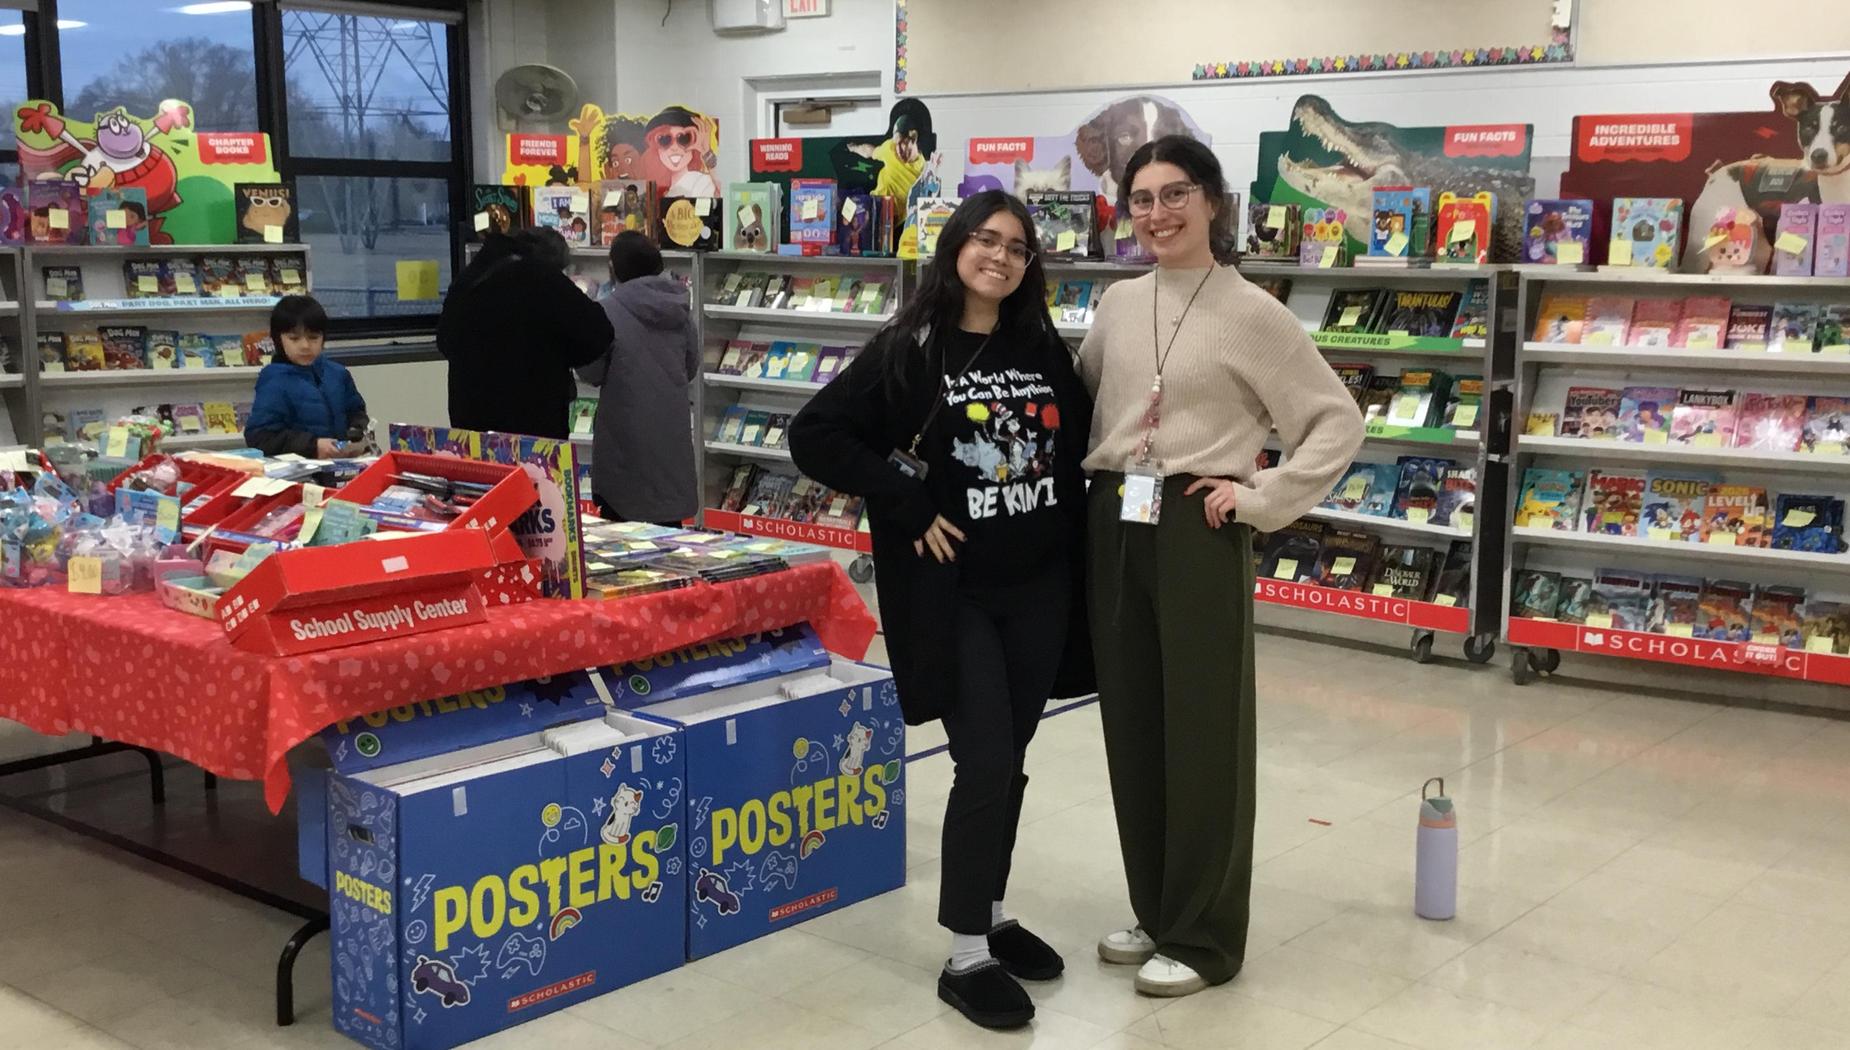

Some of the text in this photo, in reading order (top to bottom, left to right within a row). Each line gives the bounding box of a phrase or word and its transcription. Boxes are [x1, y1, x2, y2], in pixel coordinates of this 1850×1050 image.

[1453, 130, 1517, 143] FUN FACTS
[1594, 123, 1676, 135] INCREDIBLE
[207, 138, 254, 147] CHAPTER
[519, 139, 558, 148] FRIENDS
[759, 143, 793, 153] WINNING
[976, 142, 1027, 152] FUN FACTS
[1589, 134, 1680, 147] ADVENTURES
[215, 146, 250, 155] BOOKS
[519, 147, 558, 156] FOREVER
[765, 151, 789, 161] READS
[121, 300, 146, 308] PART
[173, 299, 198, 307] PART
[224, 298, 240, 306] ALL
[1330, 334, 1391, 346] CREATURES
[959, 375, 970, 387] A
[968, 370, 1006, 386] World
[1005, 368, 1043, 383] Where
[943, 390, 967, 407] You
[967, 387, 993, 400] Can
[991, 384, 1010, 401] Be
[563, 468, 577, 543] BOOKMARKS
[966, 486, 999, 520] BE
[755, 520, 853, 545] SCHOLASTIC
[1265, 583, 1406, 617] SCHOLASTIC
[291, 613, 356, 641] School
[353, 605, 415, 632] Supply
[414, 598, 469, 621] Center
[711, 763, 887, 866] POSTERS
[335, 869, 393, 916] POSTERS
[433, 829, 660, 952] POSTERS
[778, 890, 837, 917] SCHOLASTIC
[519, 971, 595, 1007] SCHOLASTIC
